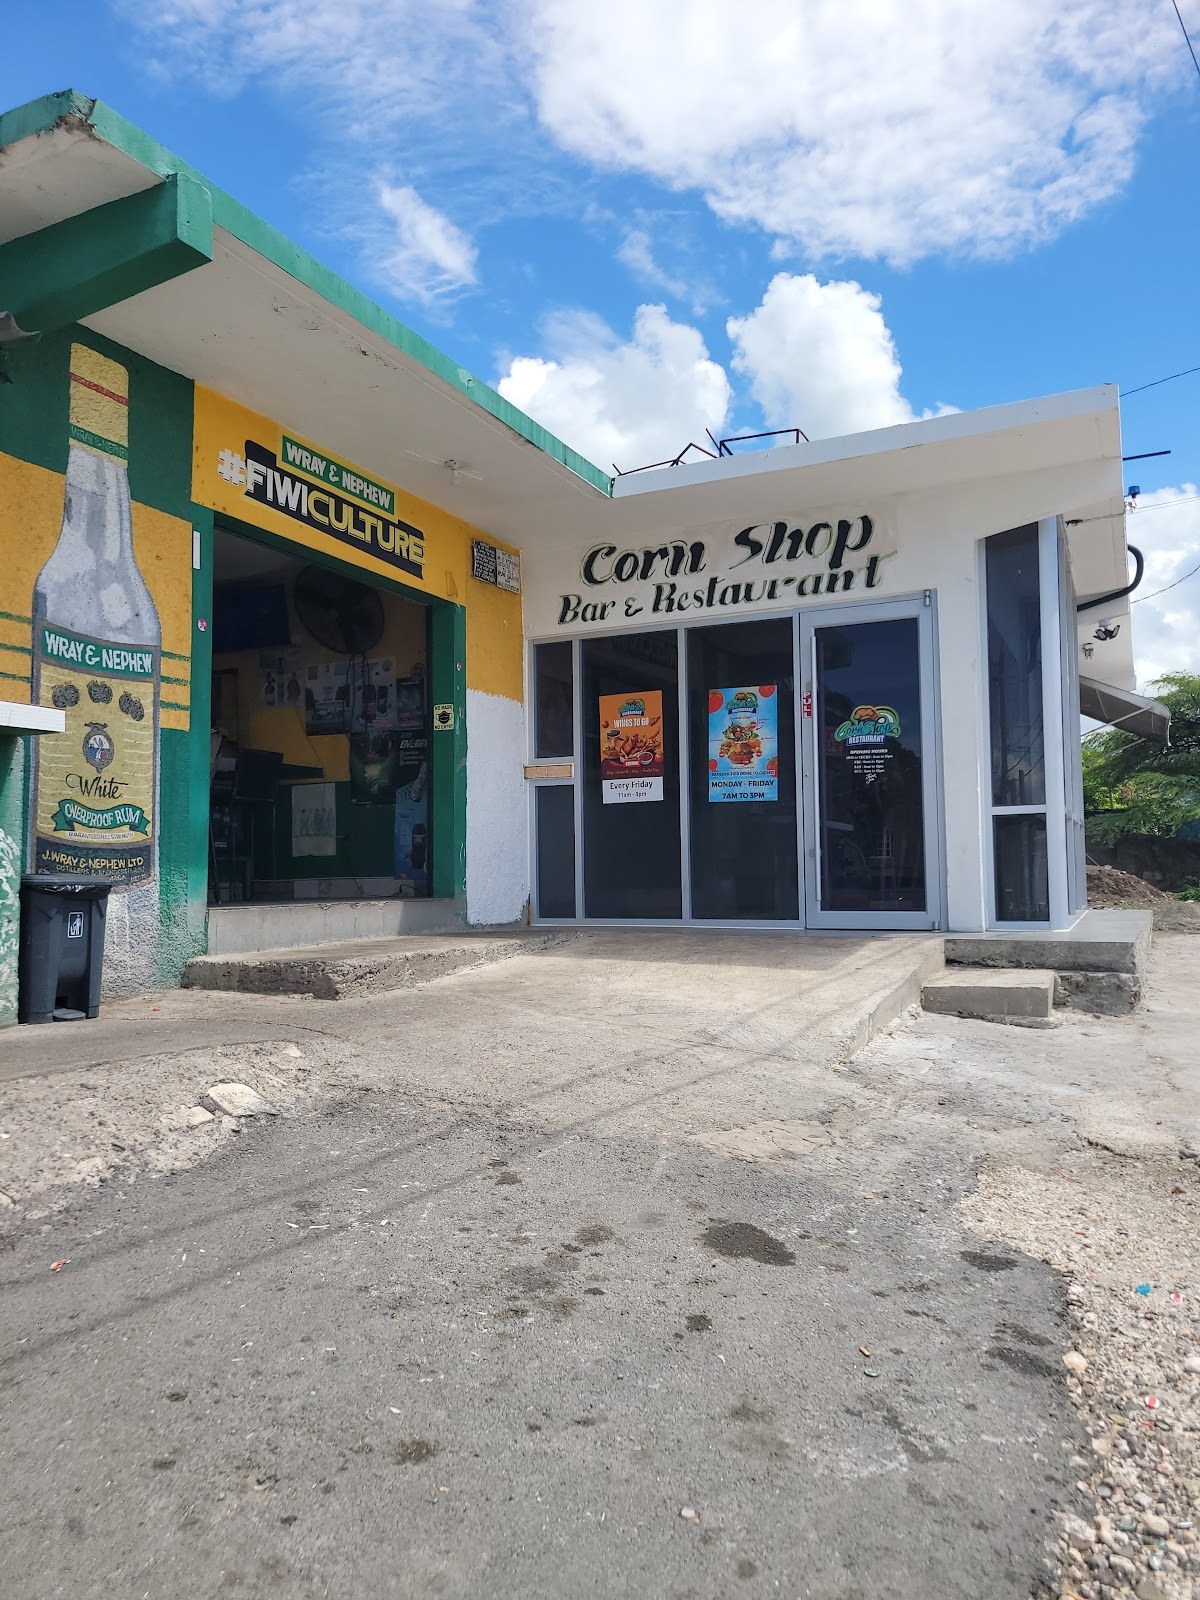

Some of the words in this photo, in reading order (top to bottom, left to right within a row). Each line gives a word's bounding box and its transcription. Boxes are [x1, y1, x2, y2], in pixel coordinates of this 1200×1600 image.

[286, 442, 326, 477] WRAY
[329, 465, 340, 482] &
[342, 471, 392, 510] NEPHEW
[217, 448, 425, 566] #FIWICULTURE
[579, 539, 708, 588] Corn
[728, 515, 874, 569] Shop
[557, 593, 616, 625] Bar
[624, 597, 644, 617] &
[652, 553, 884, 614] Restaurant
[44, 630, 84, 662] WRAY
[85, 645, 100, 665] &
[102, 649, 152, 674] NEPHEW
[803, 691, 812, 718] PULL
[614, 719, 632, 728] WINGS
[634, 718, 641, 727] TO
[642, 718, 650, 726] GO
[848, 735, 884, 744] RESTAURANT
[66, 774, 129, 800] White
[610, 782, 629, 790] Every
[632, 780, 653, 789] Friday
[64, 804, 114, 826] OVERPROOF
[114, 808, 140, 824] RUM
[80, 858, 88, 868] &
[89, 858, 125, 870] NEPHEW
[127, 857, 144, 867] LTD
